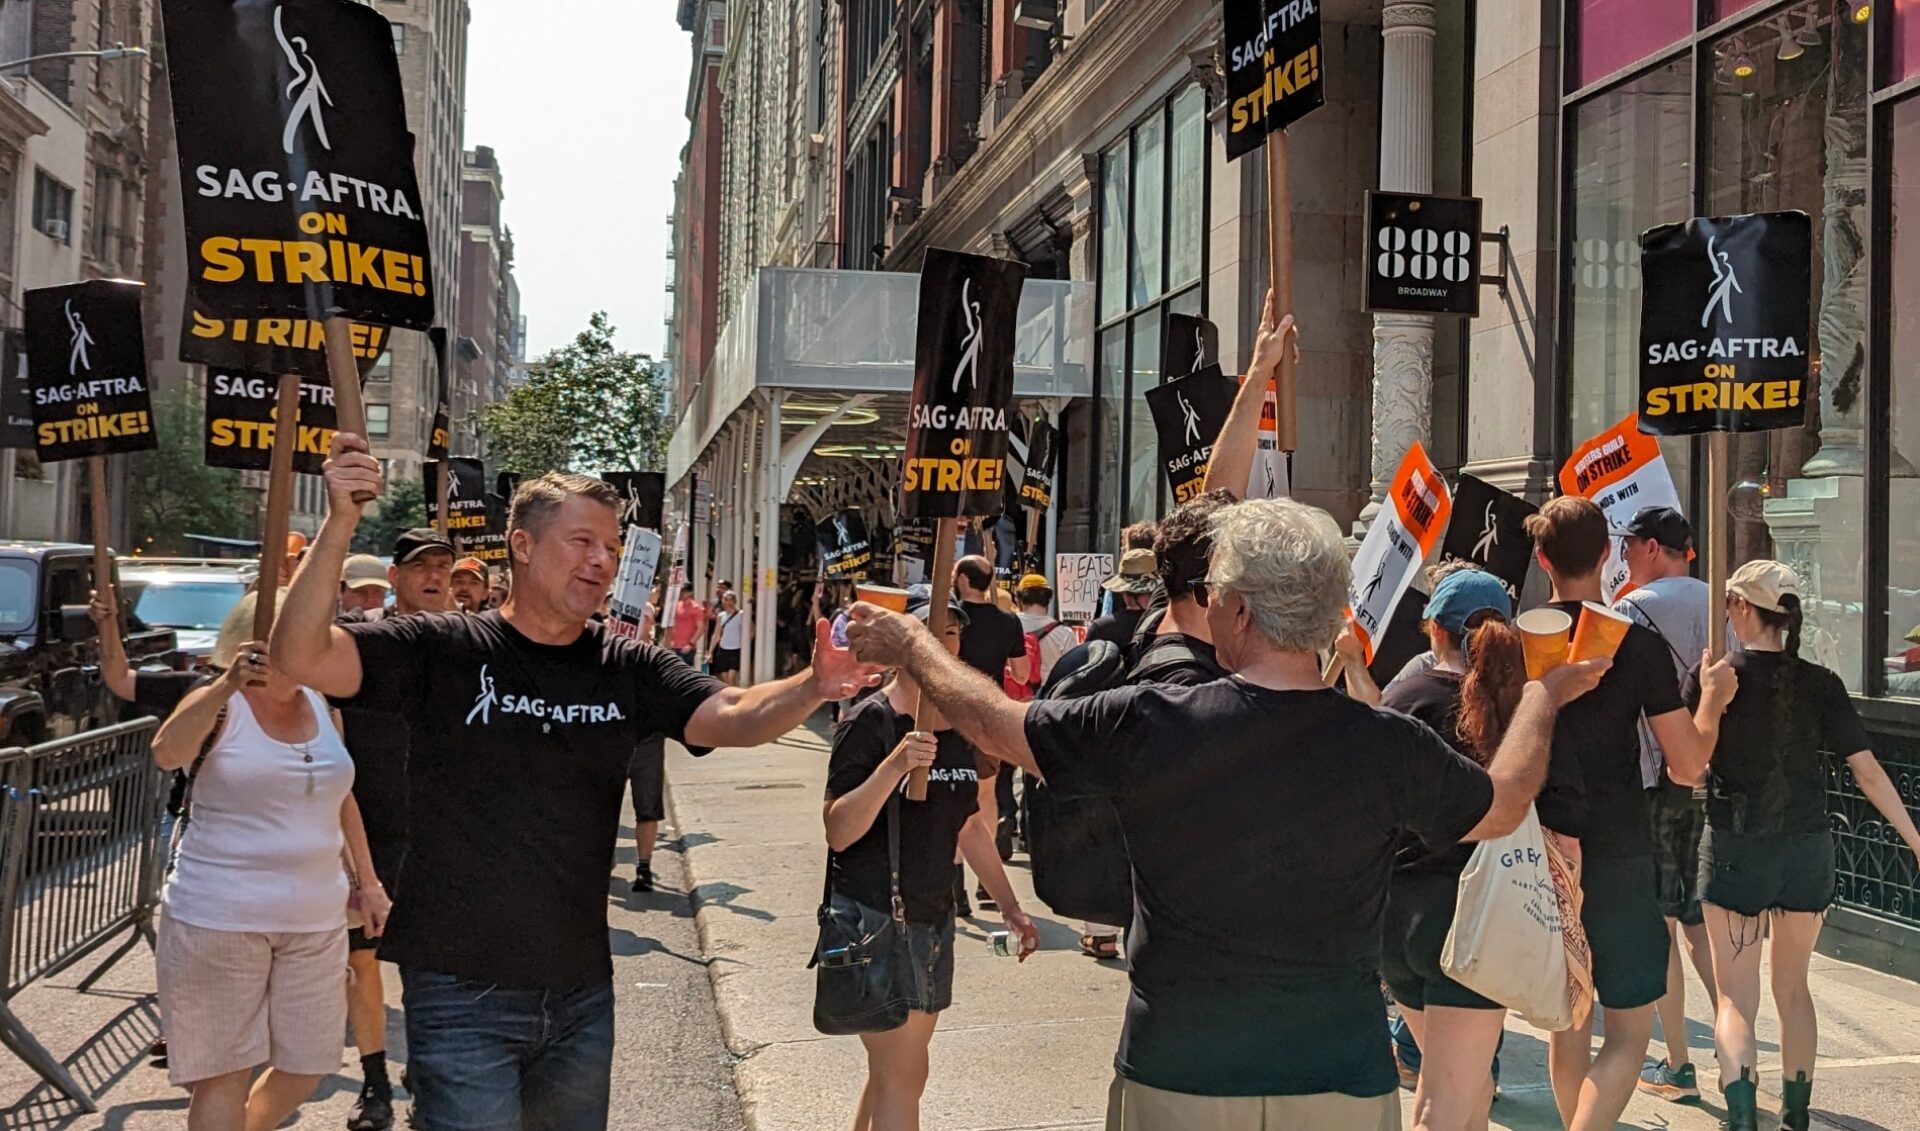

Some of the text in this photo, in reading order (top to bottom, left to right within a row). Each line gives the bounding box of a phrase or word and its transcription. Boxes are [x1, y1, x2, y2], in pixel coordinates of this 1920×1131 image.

[1231, 45, 1319, 133] STIKE!
[298, 212, 347, 235] ON
[1377, 226, 1471, 282] 888
[201, 236, 426, 297] STRIKE!
[1397, 286, 1448, 298] BROADWAY
[1704, 364, 1735, 378] ON
[76, 402, 99, 415] ON
[1646, 379, 1801, 416] STRIKE!
[37, 411, 150, 446] STRIKE!
[211, 418, 338, 455] STRKE
[1602, 434, 1625, 456] GUILD
[1576, 443, 1632, 494] ON STRIKE
[1617, 481, 1640, 502] WITH
[430, 515, 486, 531] SRIKE!
[458, 549, 508, 561] TRIKE!
[826, 552, 871, 575] STRIKE!
[1078, 555, 1113, 579] EATS
[1062, 610, 1092, 620] WRITERS
[1501, 847, 1542, 868] GREY
